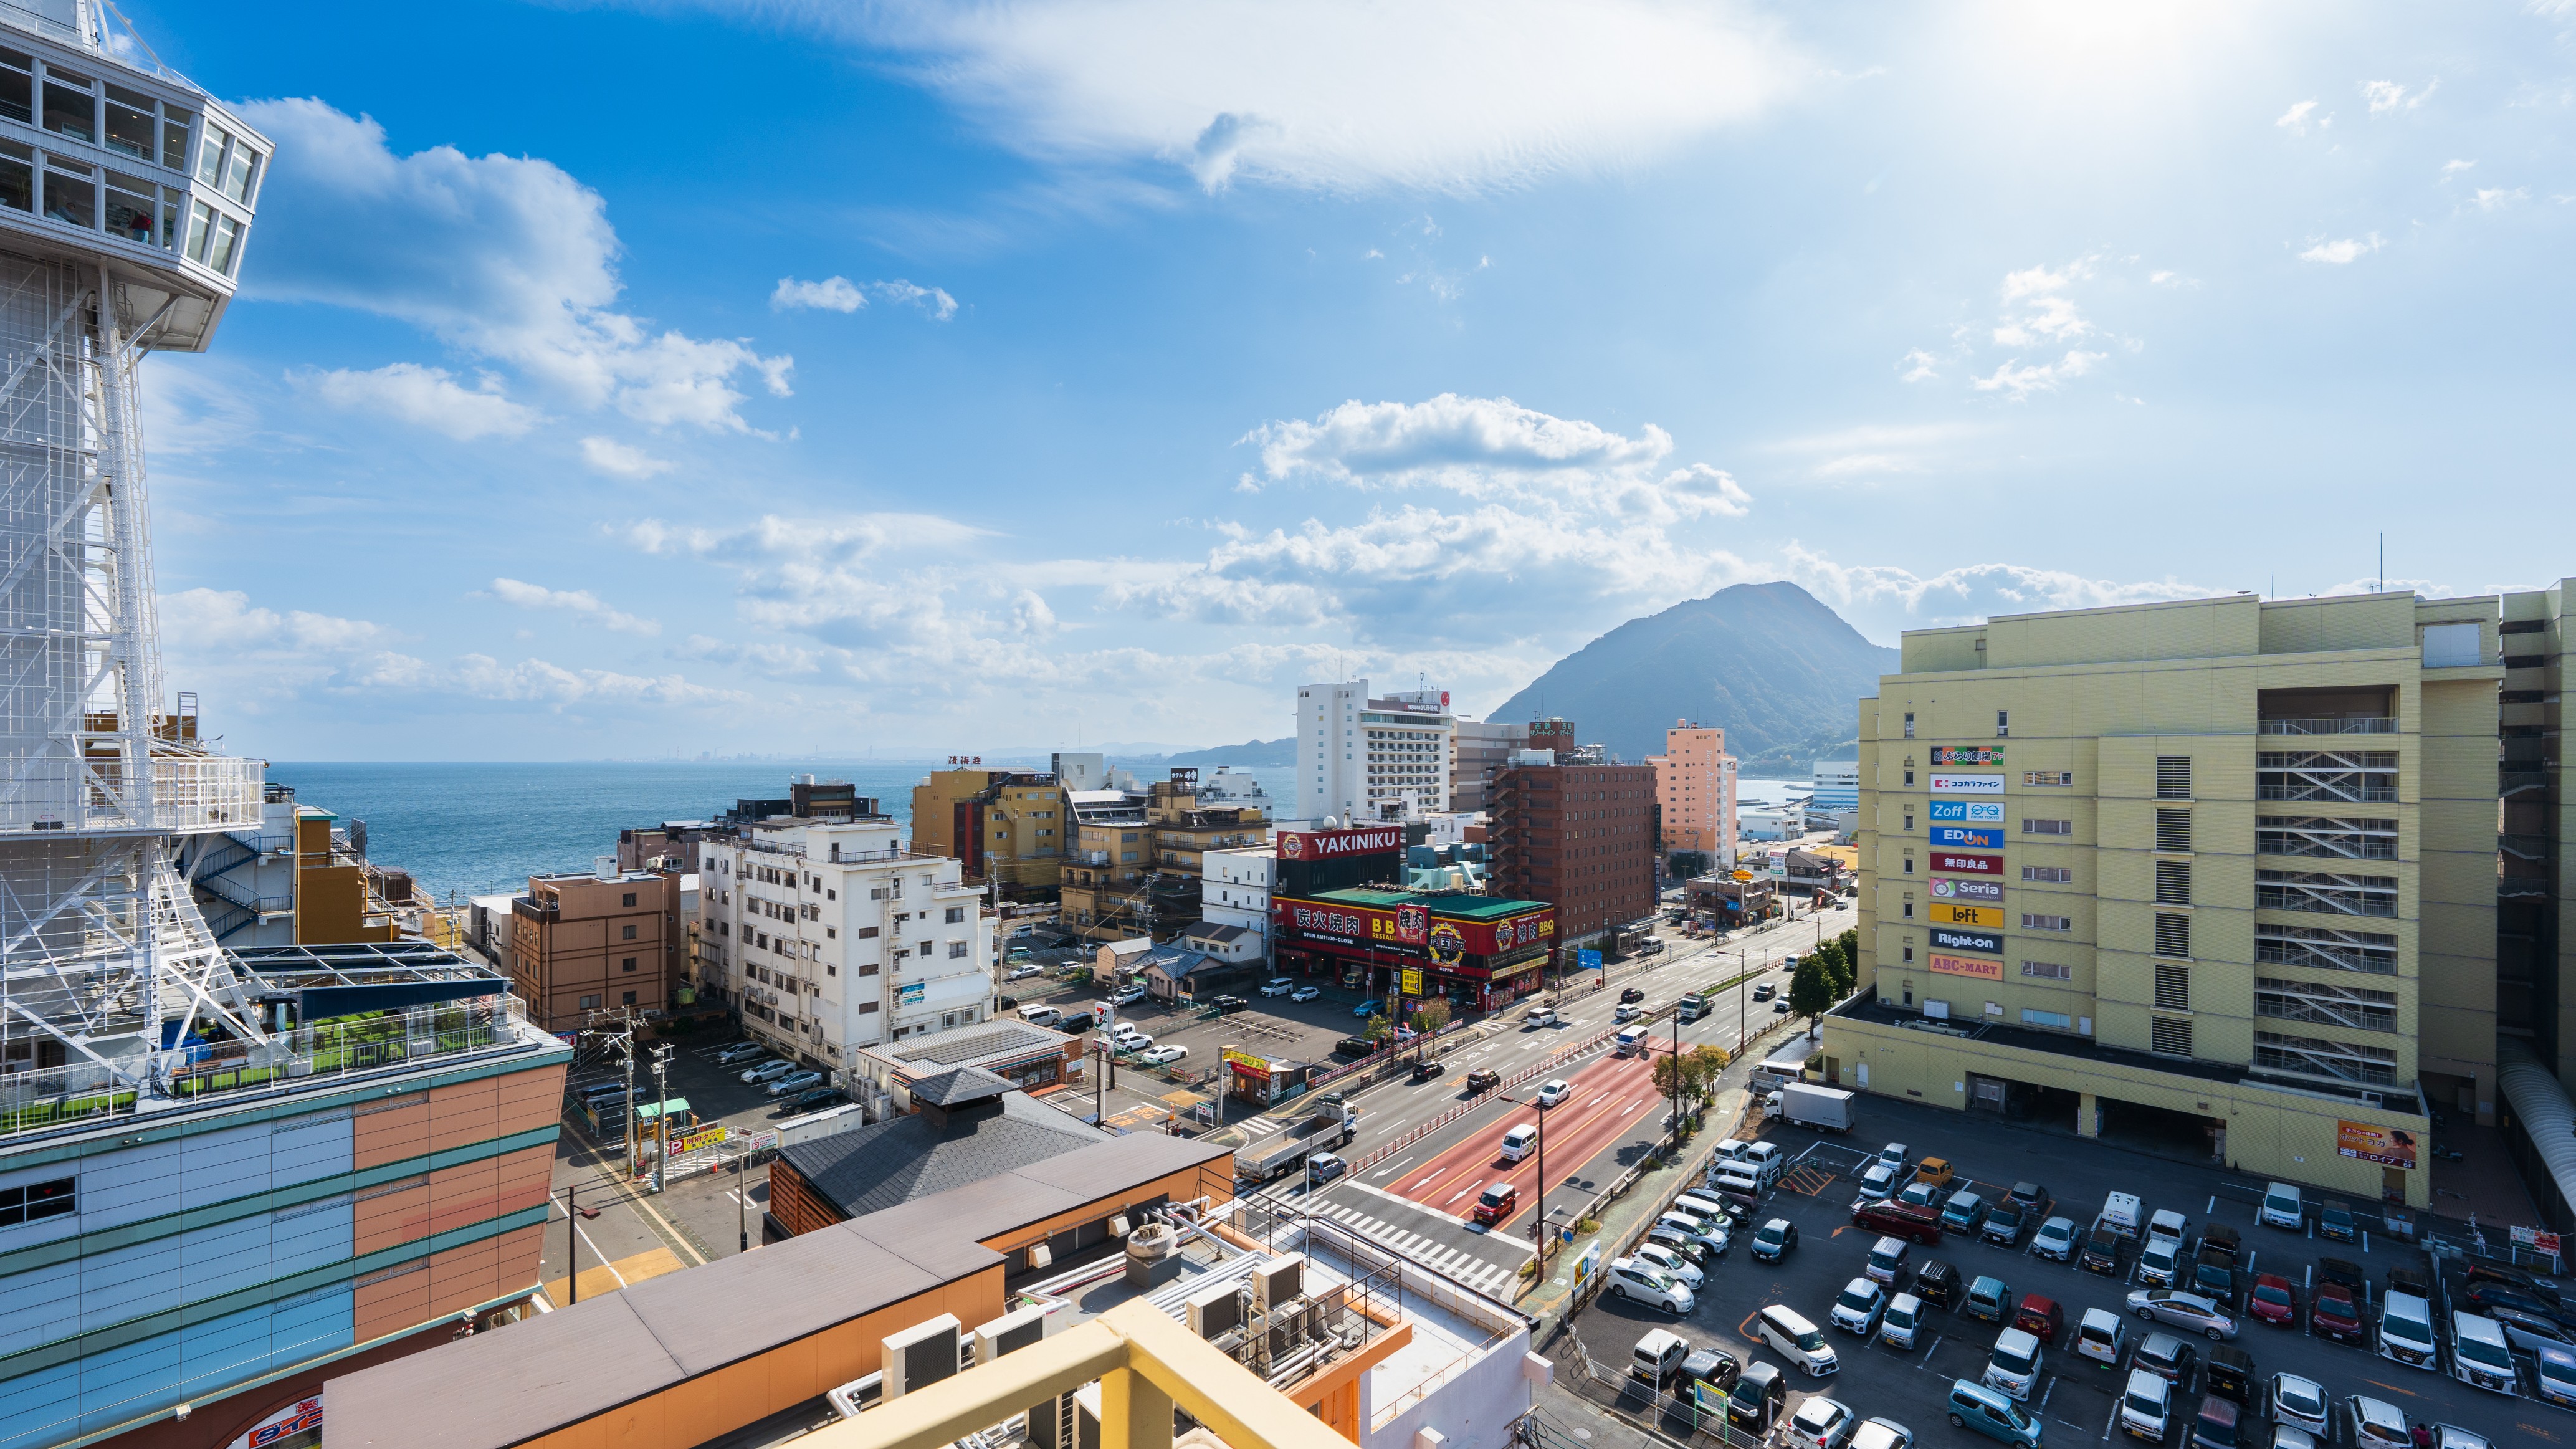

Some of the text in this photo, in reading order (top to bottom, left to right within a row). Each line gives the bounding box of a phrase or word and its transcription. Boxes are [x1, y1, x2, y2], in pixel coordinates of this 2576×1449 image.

[1944, 750, 2004, 762] ぶらり劇場 7F
[1934, 805, 1963, 817] Zoff
[1315, 831, 1396, 854] YAKINIKU
[1944, 830, 1989, 846] EDION
[1944, 858, 1988, 870] 無印良品
[1960, 882, 1999, 895] Seria
[1297, 908, 1360, 935] 炭火焼肉
[1398, 909, 1425, 932] 焼肉
[1538, 919, 1555, 933] BBQ
[1517, 922, 1537, 944] 焼肉
[1938, 932, 1993, 949] Right-on
[1932, 957, 1998, 975] ABC-MART
[686, 1131, 723, 1145] 別府タワー
[2340, 1133, 2387, 1147] ホットヨガ
[671, 1141, 683, 1154] P
[2370, 1154, 2396, 1164] ロイブ
[2112, 1194, 2135, 1202] 大分
[1583, 1260, 1588, 1275] P
